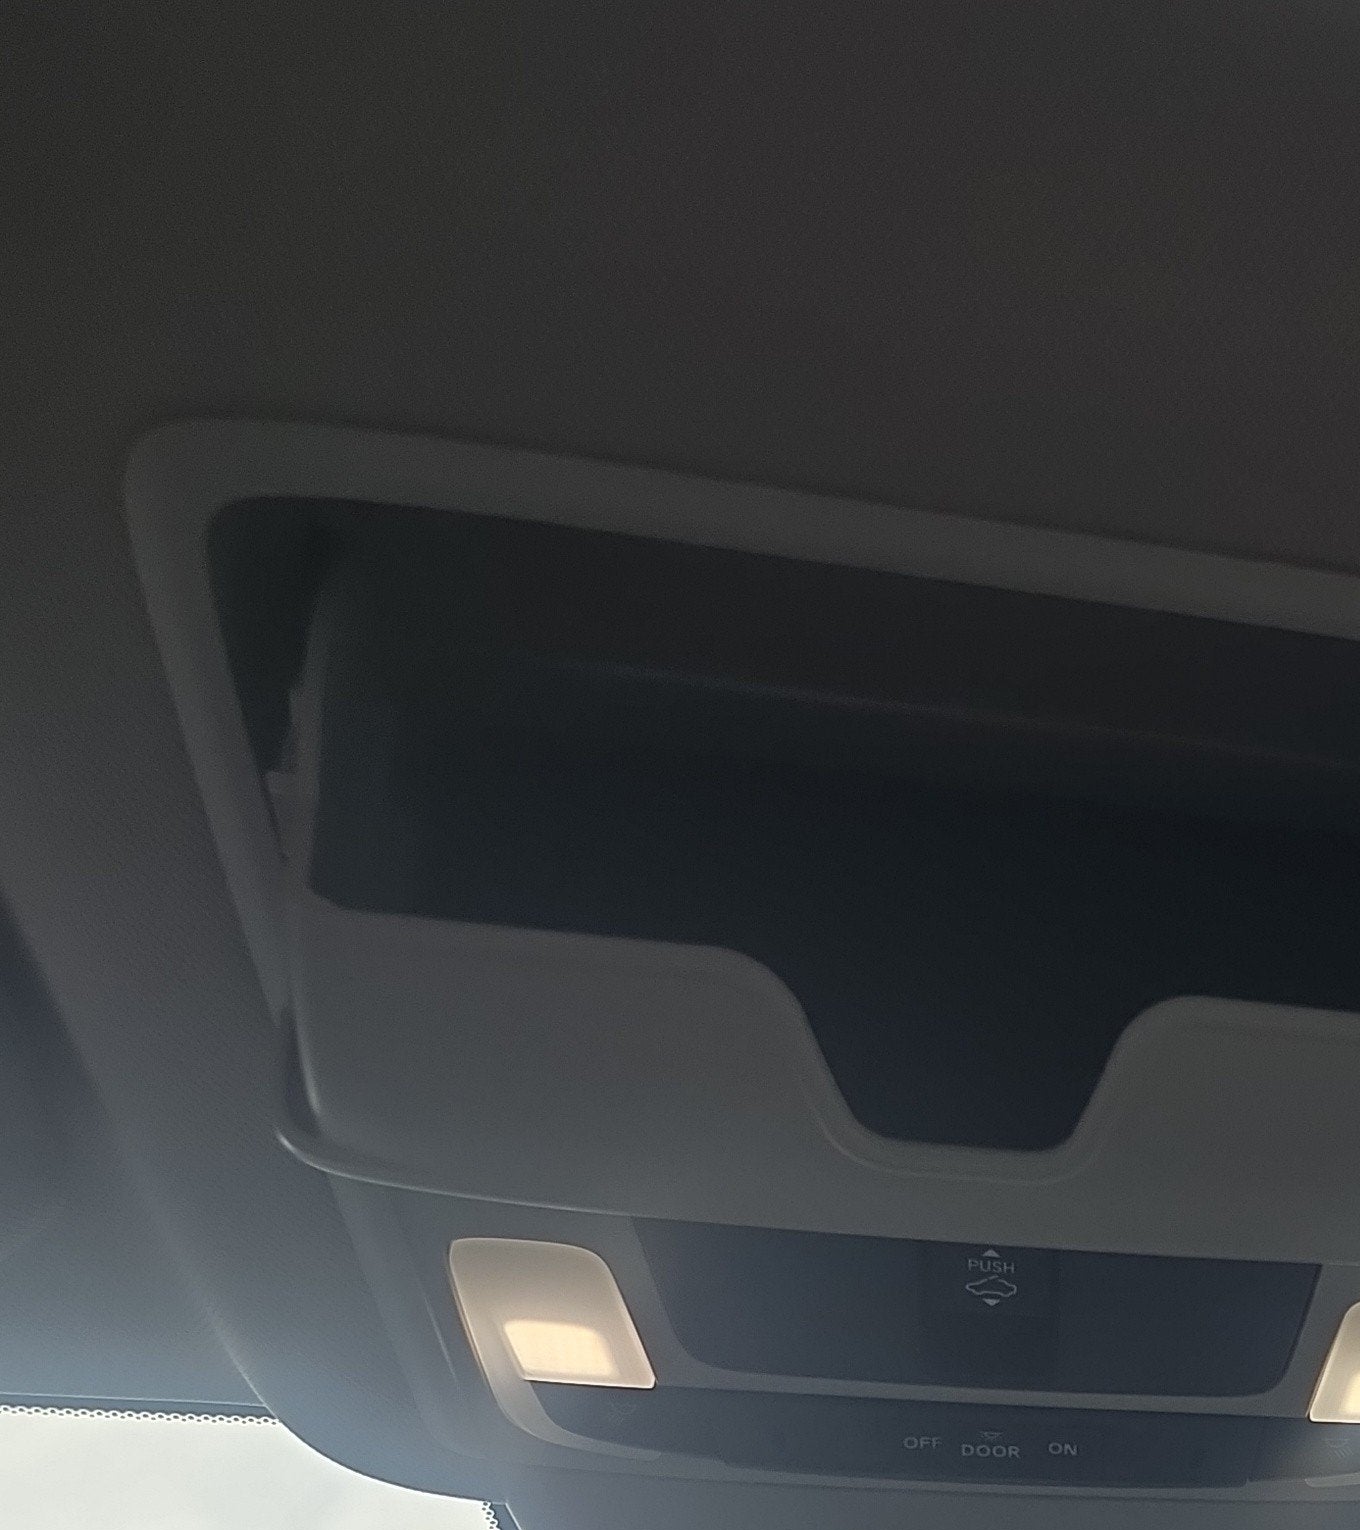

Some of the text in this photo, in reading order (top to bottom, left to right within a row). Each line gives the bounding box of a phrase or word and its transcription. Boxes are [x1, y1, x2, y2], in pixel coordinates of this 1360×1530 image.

[967, 1258, 1015, 1274] PUSH
[902, 1436, 1079, 1459] OFF DOOR ON
